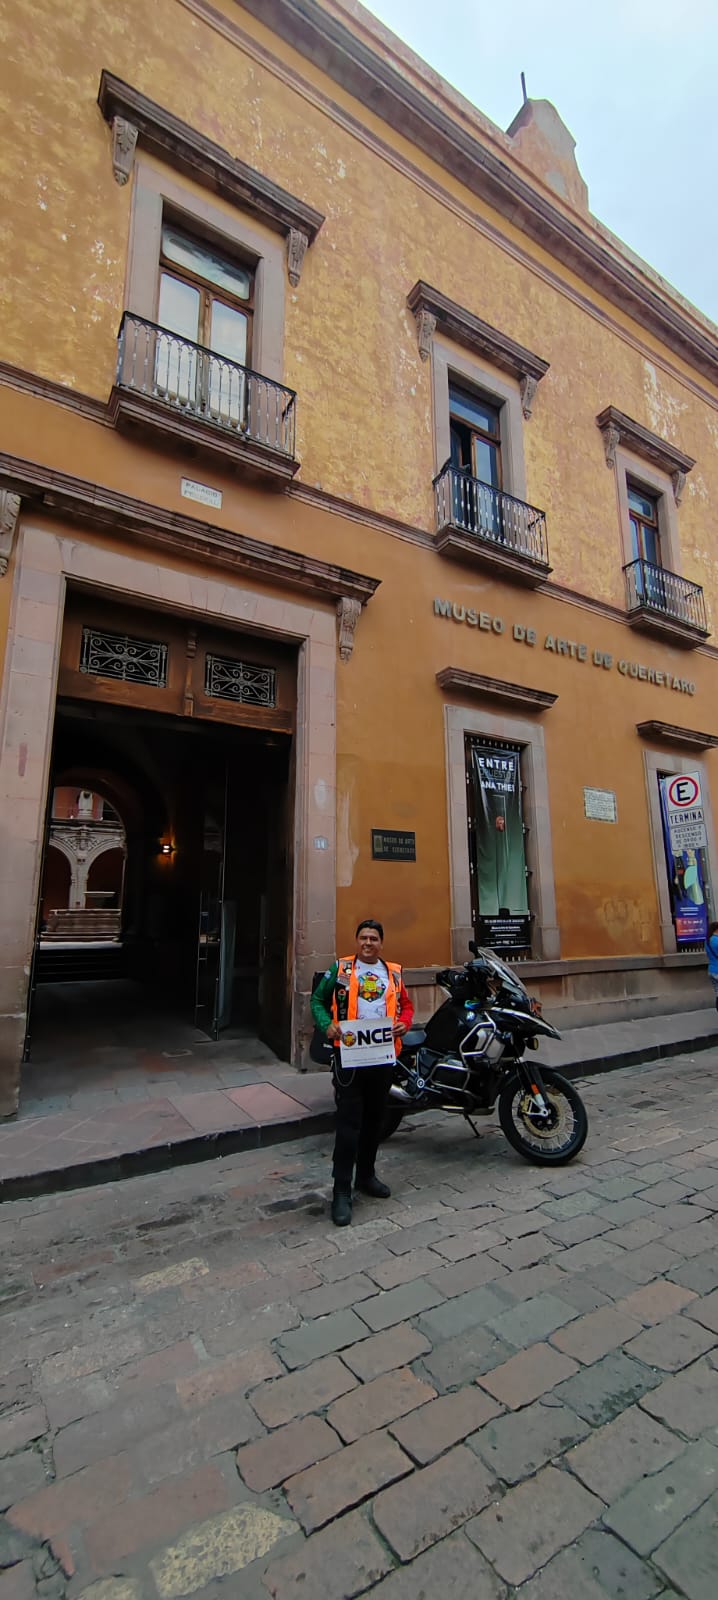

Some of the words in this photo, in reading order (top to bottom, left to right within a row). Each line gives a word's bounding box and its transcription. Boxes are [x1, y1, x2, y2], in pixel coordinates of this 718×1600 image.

[433, 597, 505, 634] MUSEO
[513, 623, 537, 645] DE
[544, 635, 588, 662] ARTE
[593, 648, 613, 670] DE
[617, 658, 697, 696] QUERETARO
[478, 757, 514, 771] ENTRE
[480, 780, 496, 790] ANA
[676, 781, 691, 802] E
[670, 810, 703, 825] TERMINA
